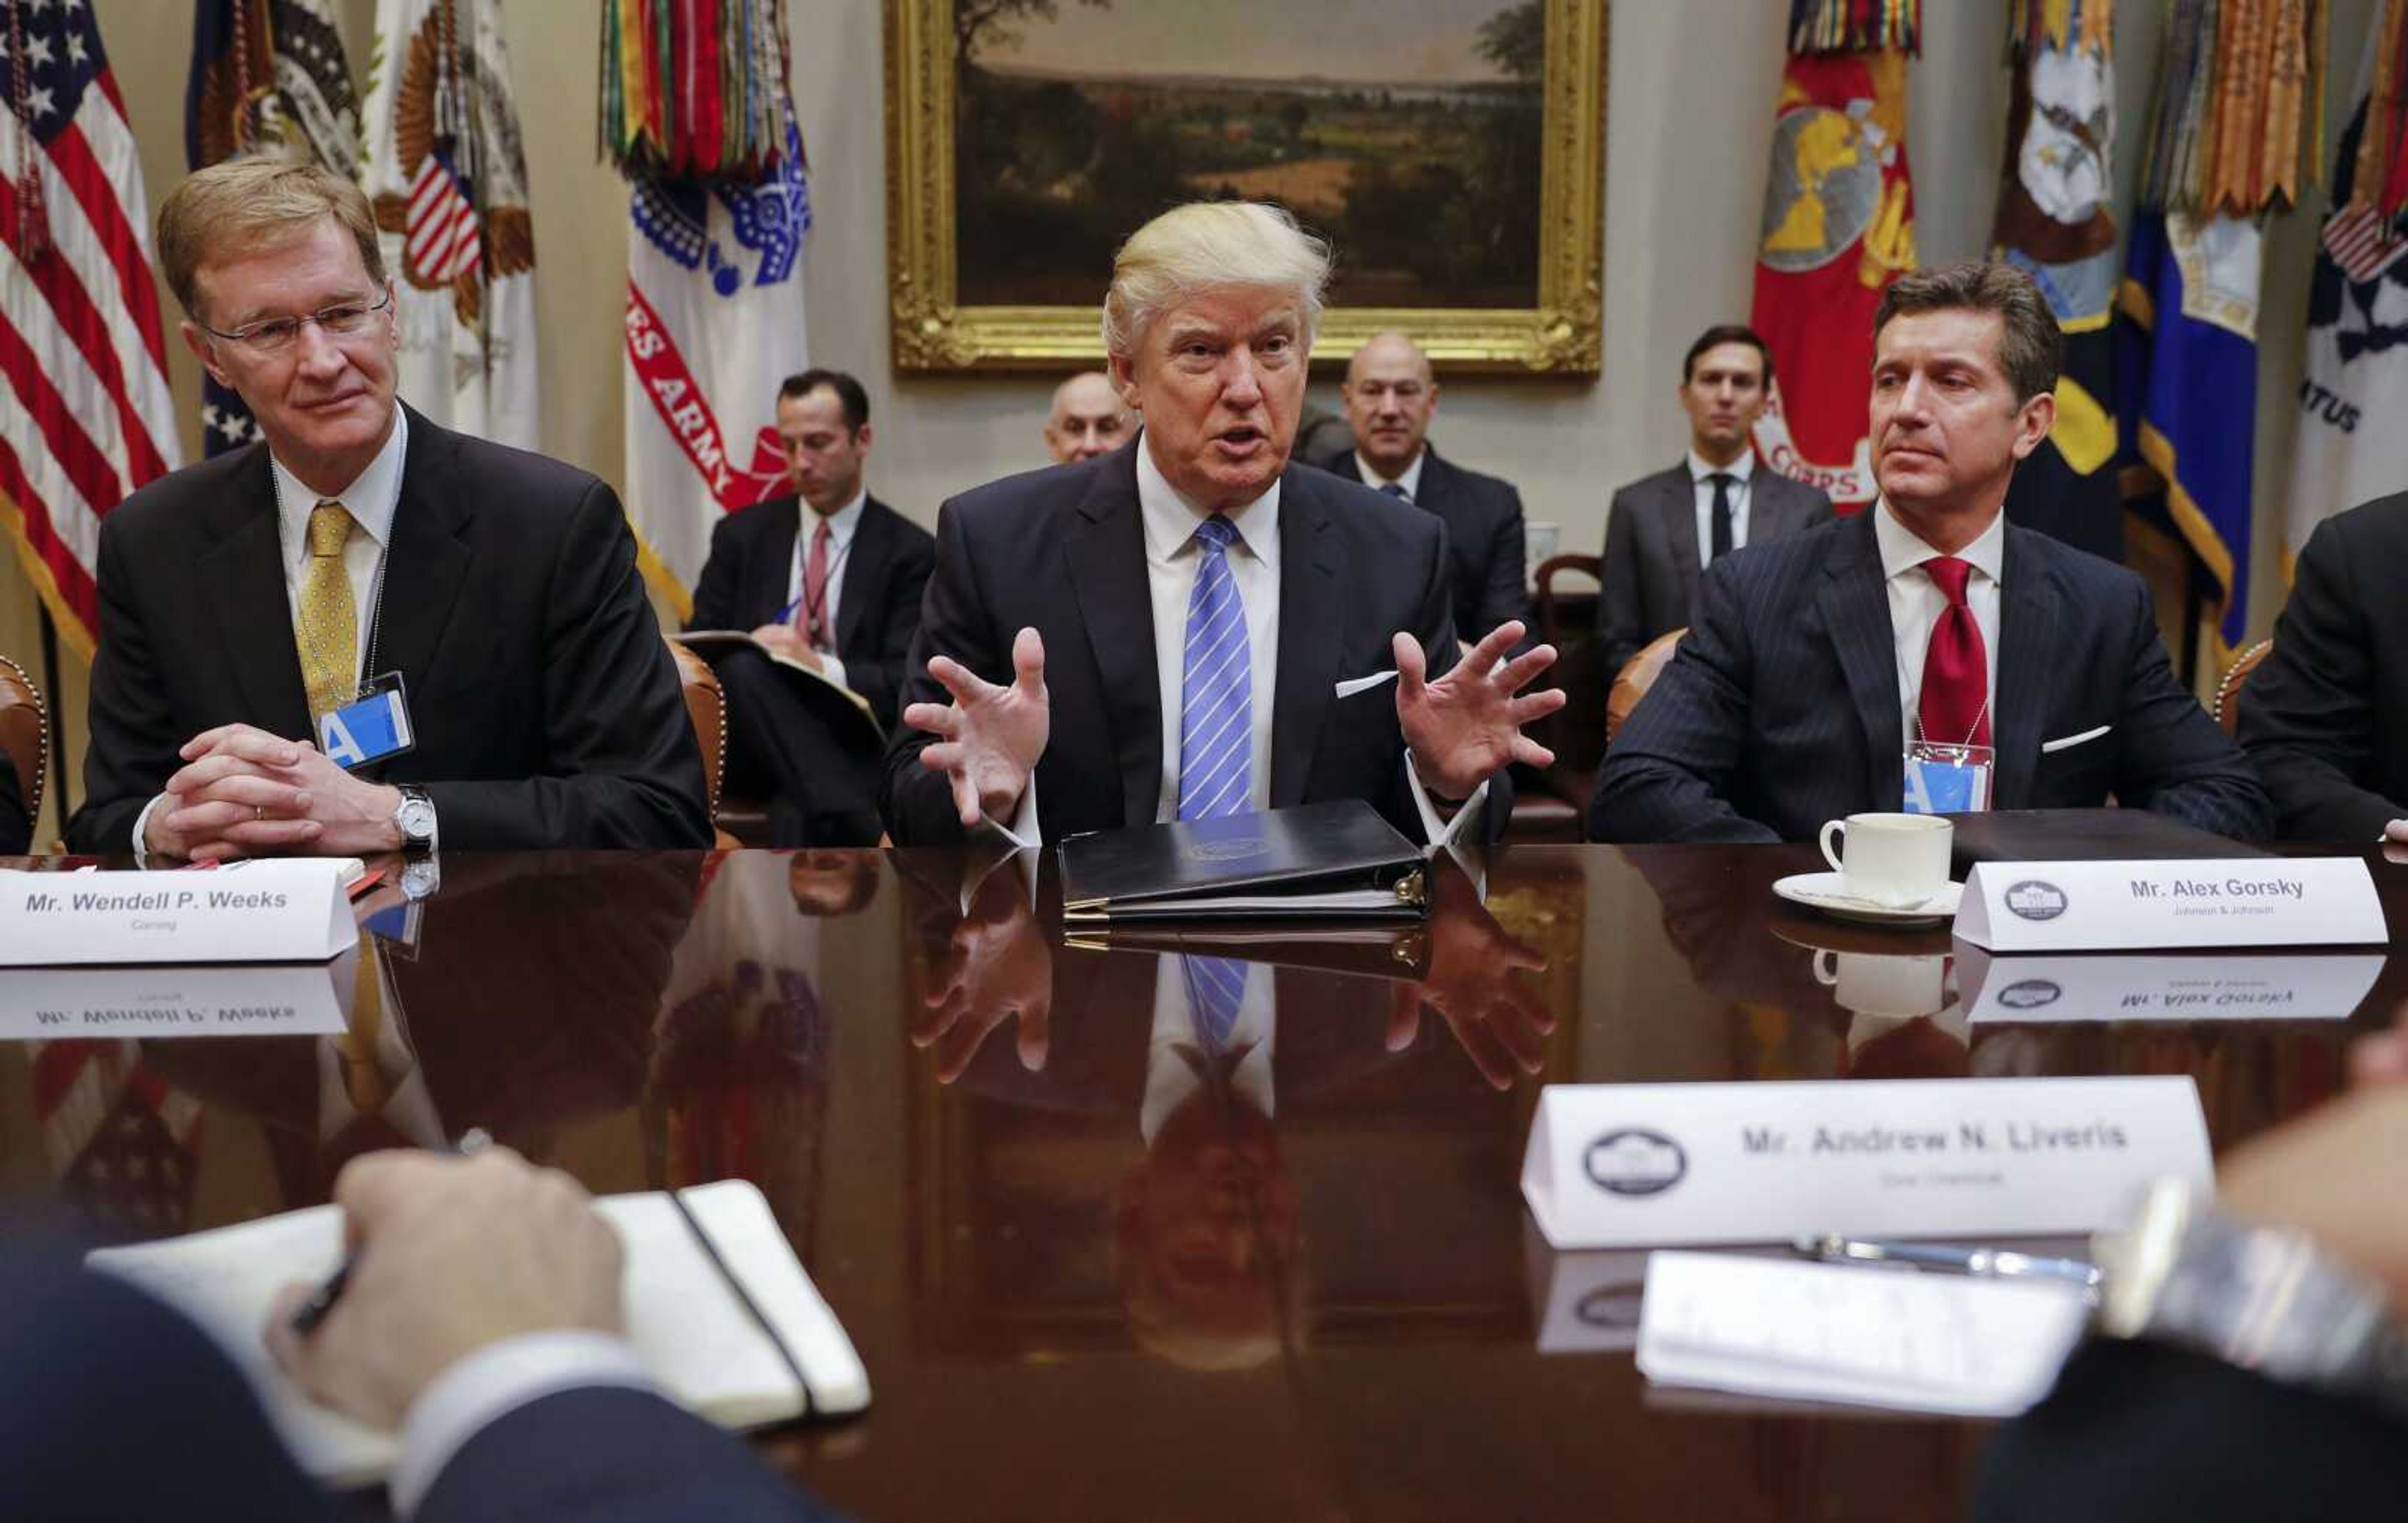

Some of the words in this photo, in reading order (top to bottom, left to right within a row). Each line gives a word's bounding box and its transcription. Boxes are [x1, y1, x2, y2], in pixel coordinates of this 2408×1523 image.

[650, 376, 732, 494] ARMY
[320, 712, 364, 764] A
[26, 893, 62, 912] Mr.
[73, 892, 169, 911] Wendell
[177, 891, 199, 910] P.
[209, 890, 287, 909] Weeks
[2131, 880, 2166, 897] Mr.
[2173, 880, 2221, 897] Alex
[2226, 878, 2303, 899] Gorsky
[1744, 1127, 1798, 1153] Mr.
[1813, 1125, 1945, 1152] Andrew
[1960, 1124, 2000, 1151] N.
[2009, 1122, 2128, 1151] Liveris
